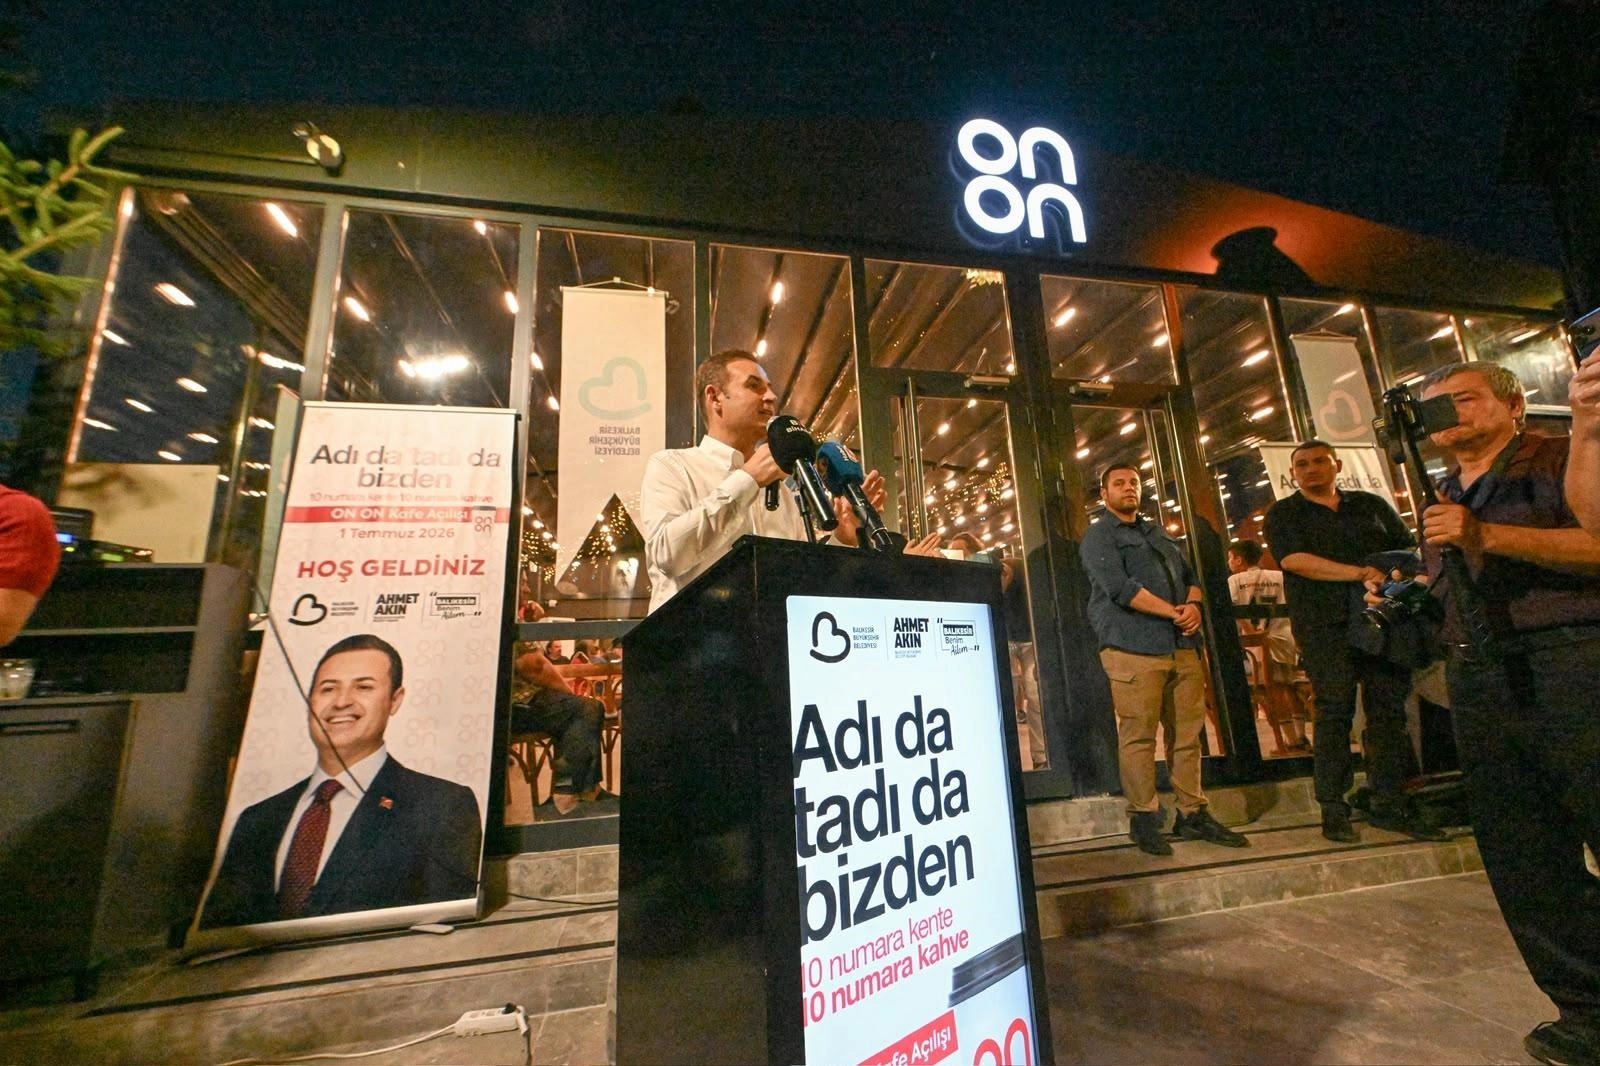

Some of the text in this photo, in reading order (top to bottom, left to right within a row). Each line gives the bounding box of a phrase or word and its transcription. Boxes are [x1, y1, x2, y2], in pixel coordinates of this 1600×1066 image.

[310, 444, 358, 465] Adı
[367, 445, 400, 466] da
[468, 448, 501, 468] da
[357, 468, 453, 489] bizden
[330, 507, 356, 520] ON
[360, 507, 385, 520] ON
[388, 507, 423, 520] Kafe
[340, 528, 455, 539] 1 Temmuz 2026
[297, 554, 486, 583] HOŞ GELDİNİZ
[374, 604, 407, 615] AKIN
[376, 593, 420, 605] AHMET
[893, 617, 929, 633] AHMET
[895, 633, 922, 648] AKIN
[794, 695, 954, 778] Adı da
[795, 758, 970, 859] tadı da
[797, 834, 975, 945] bizden
[829, 929, 905, 980] numara
[908, 907, 954, 944] kente
[831, 956, 913, 1013] numara
[918, 929, 969, 970] kahve
